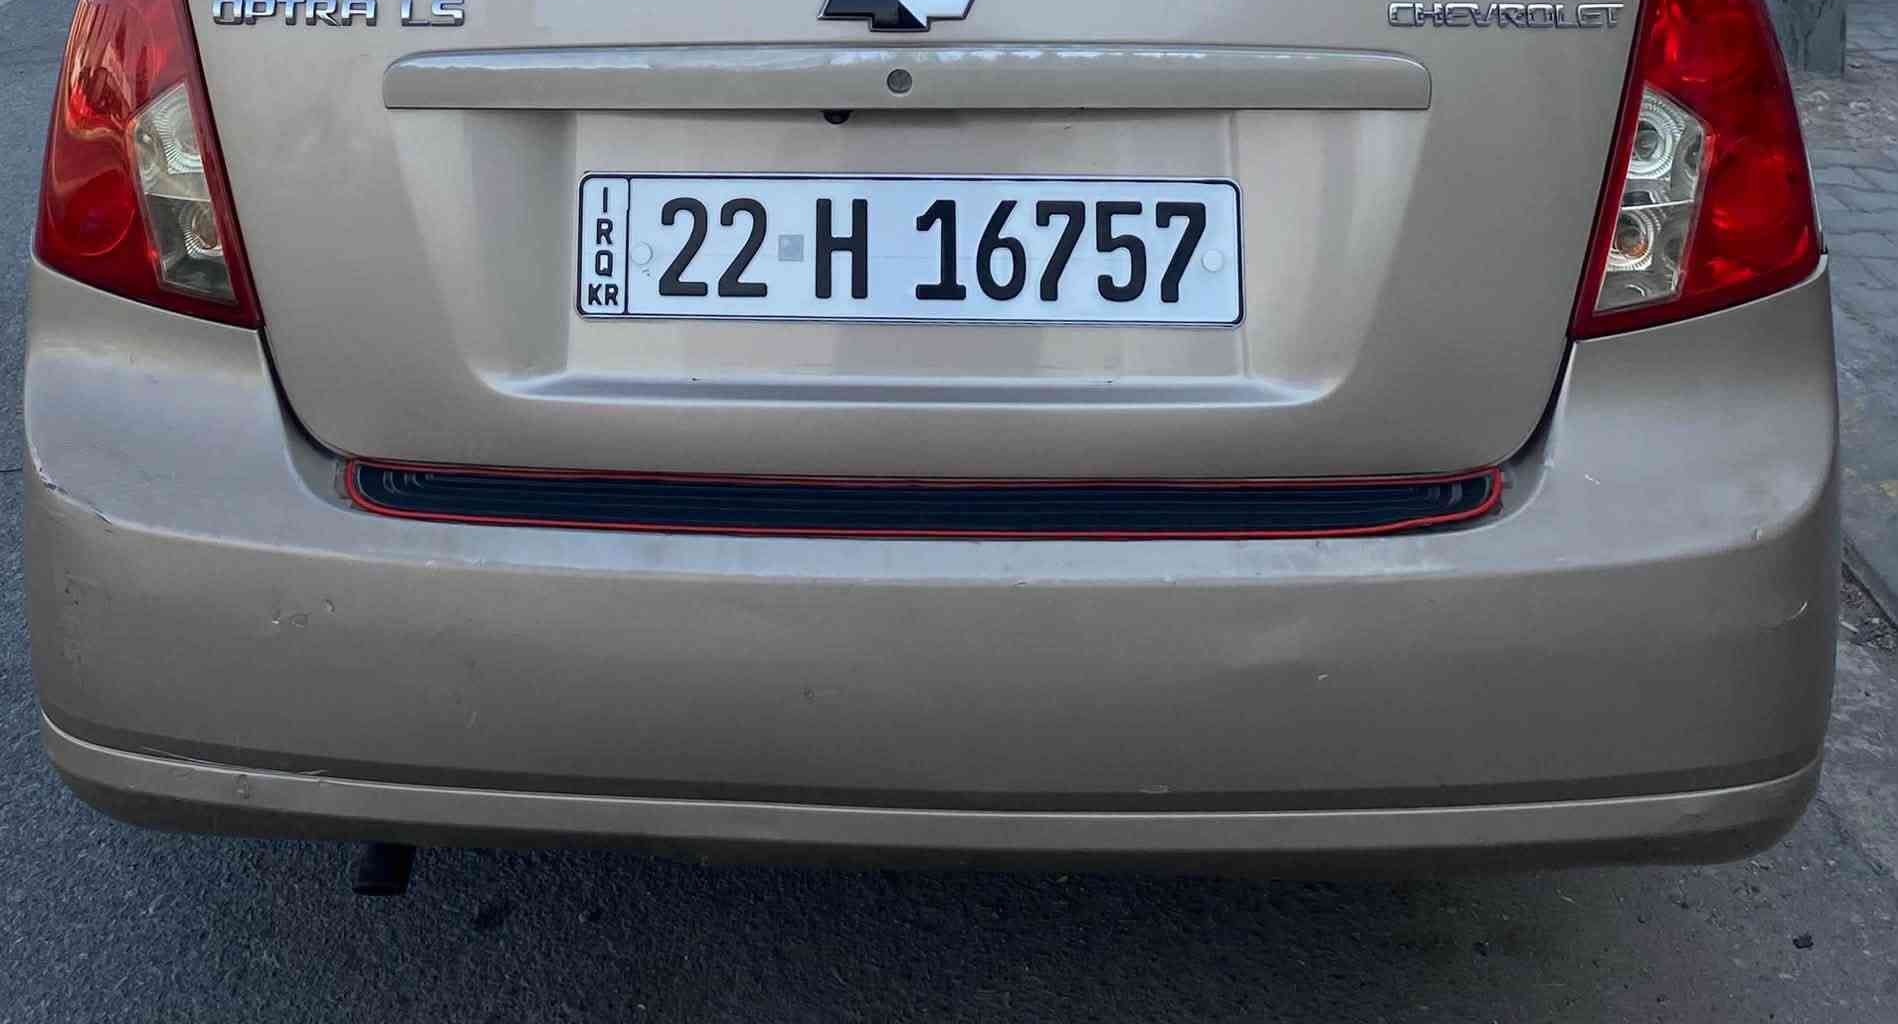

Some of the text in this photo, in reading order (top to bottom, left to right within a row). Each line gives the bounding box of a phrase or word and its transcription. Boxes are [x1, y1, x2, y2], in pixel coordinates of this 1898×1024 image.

[1387, 2, 1625, 28] CHEVROLET
[658, 197, 1208, 304] 22 H 16757
[587, 283, 618, 307] KR
